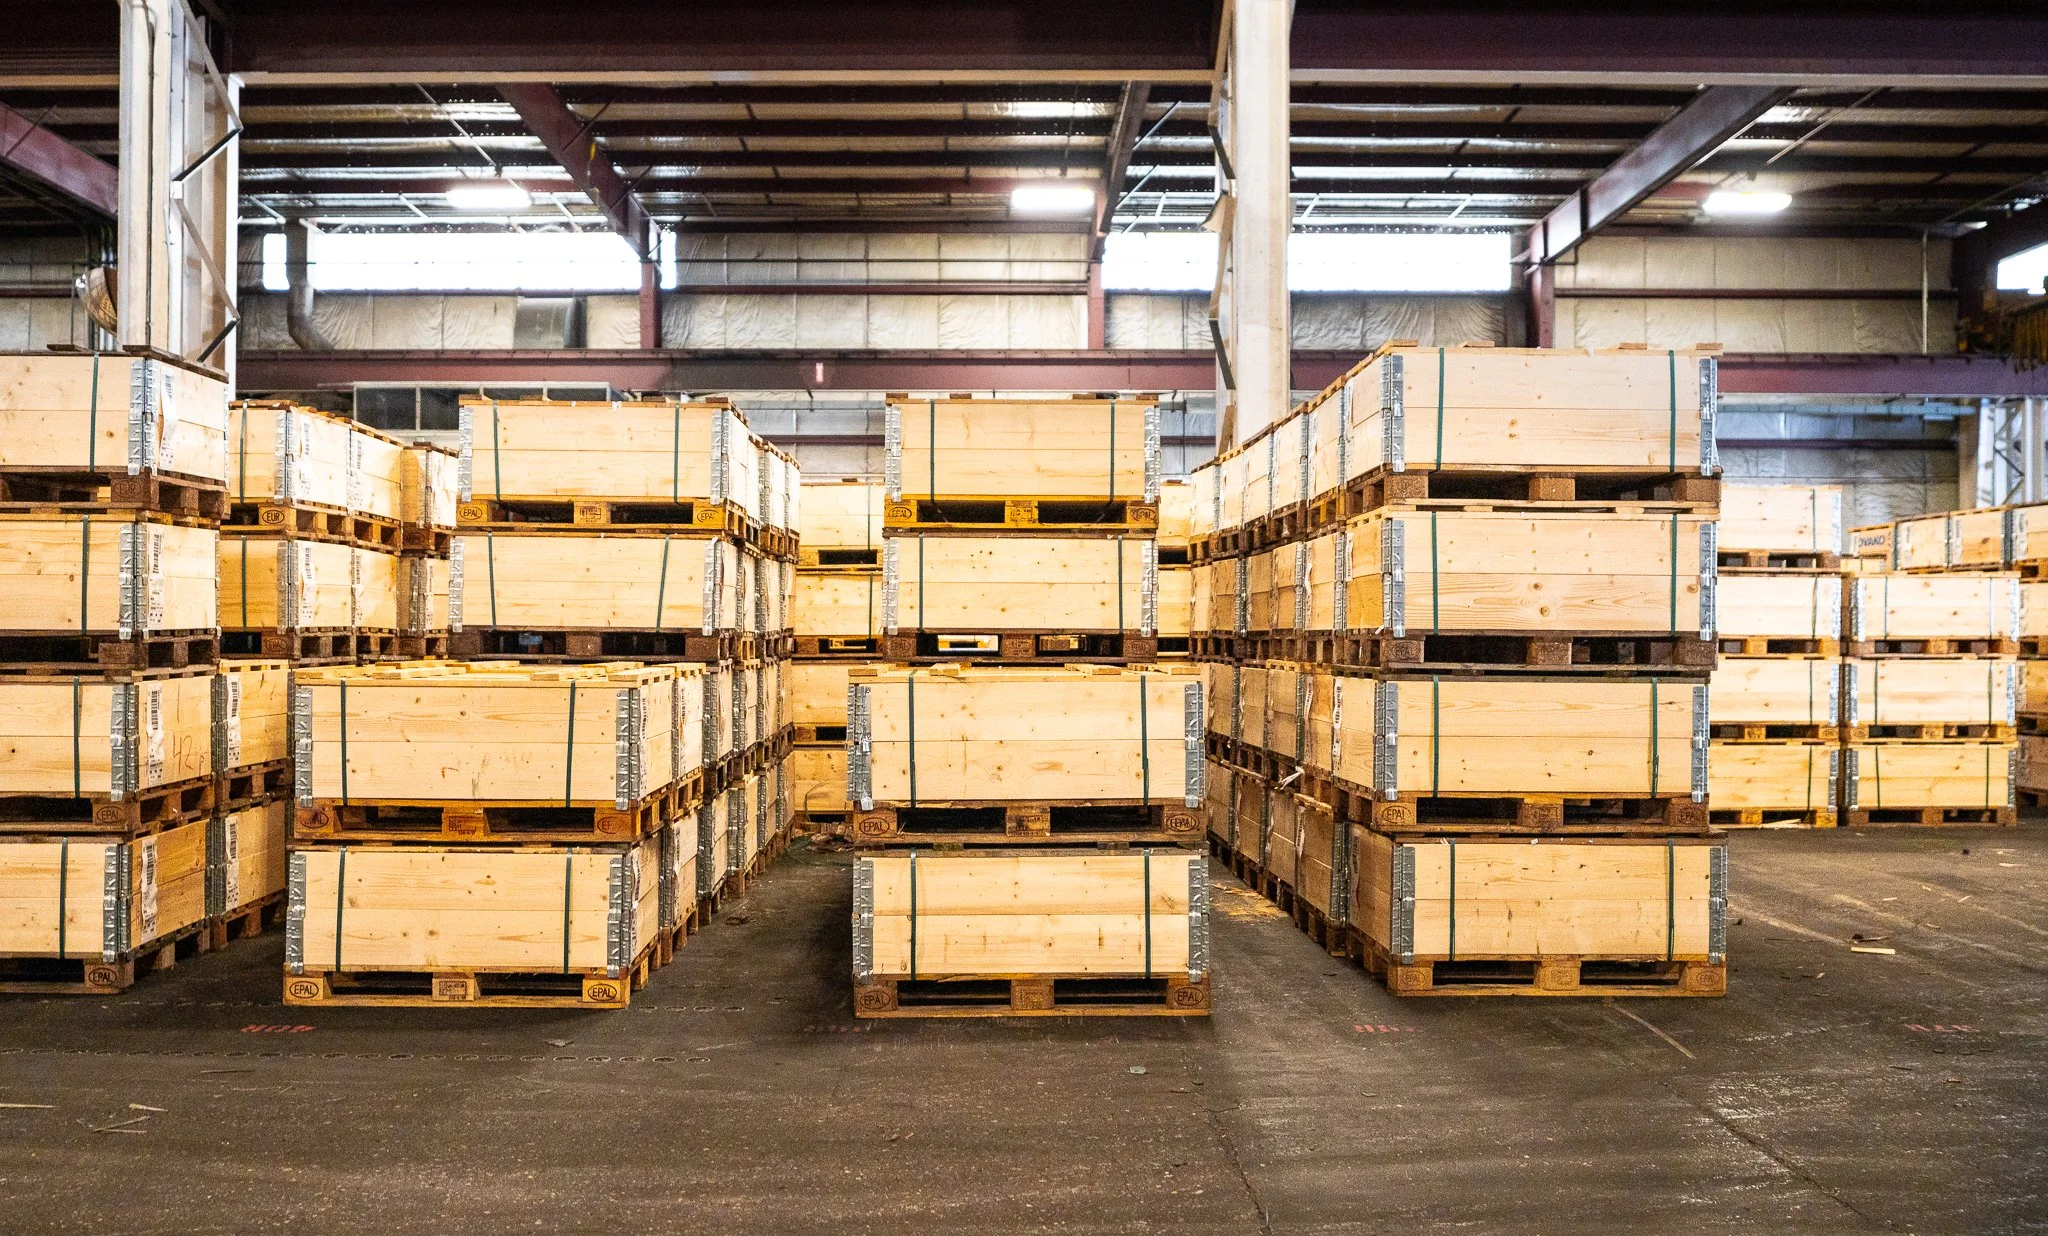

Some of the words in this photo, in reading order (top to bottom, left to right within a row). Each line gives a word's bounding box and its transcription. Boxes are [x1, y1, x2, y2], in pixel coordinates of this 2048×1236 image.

[267, 512, 280, 522] EUR
[463, 507, 478, 518] EPAL
[101, 810, 119, 821] EPAL
[1386, 808, 1406, 821] EPAL
[863, 820, 884, 832] EPAL
[93, 971, 111, 982] EPAL
[294, 984, 314, 995] EPAL
[592, 987, 613, 998] EPAL
[863, 995, 886, 1006] EPAL
[1177, 992, 1200, 1002] EPAL
